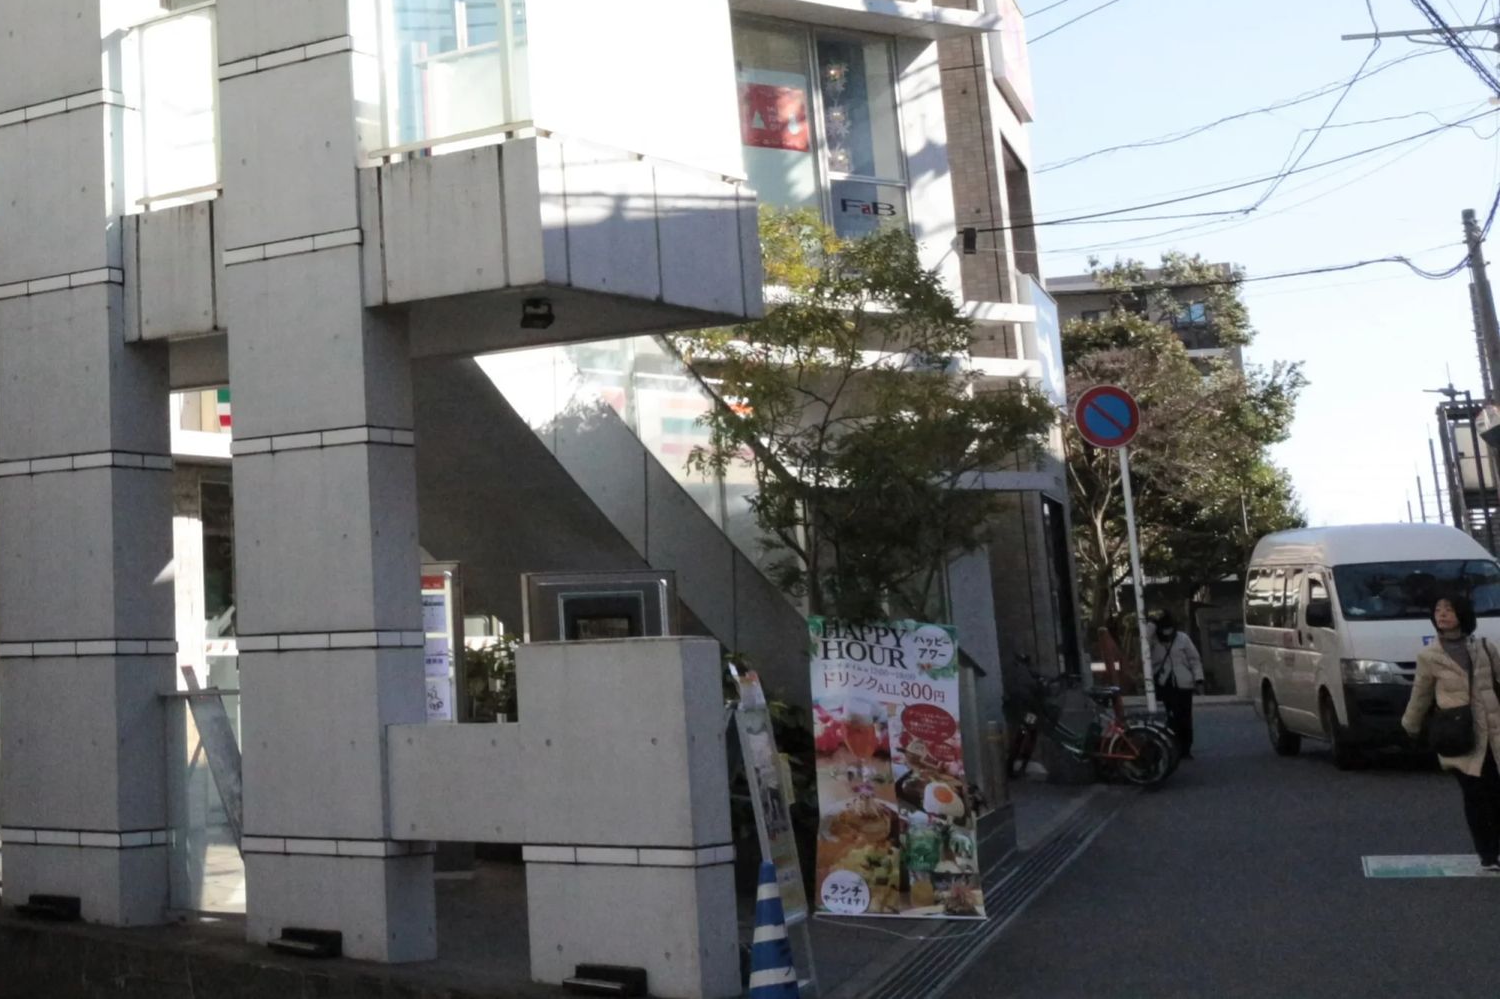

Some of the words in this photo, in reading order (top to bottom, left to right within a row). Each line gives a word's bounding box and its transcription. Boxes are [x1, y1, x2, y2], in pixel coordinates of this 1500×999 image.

[821, 619, 907, 648] HAPPY
[914, 635, 950, 648] ハッピー
[820, 639, 908, 669] HOUR
[918, 648, 946, 659] アワー
[830, 883, 862, 897] ランチ
